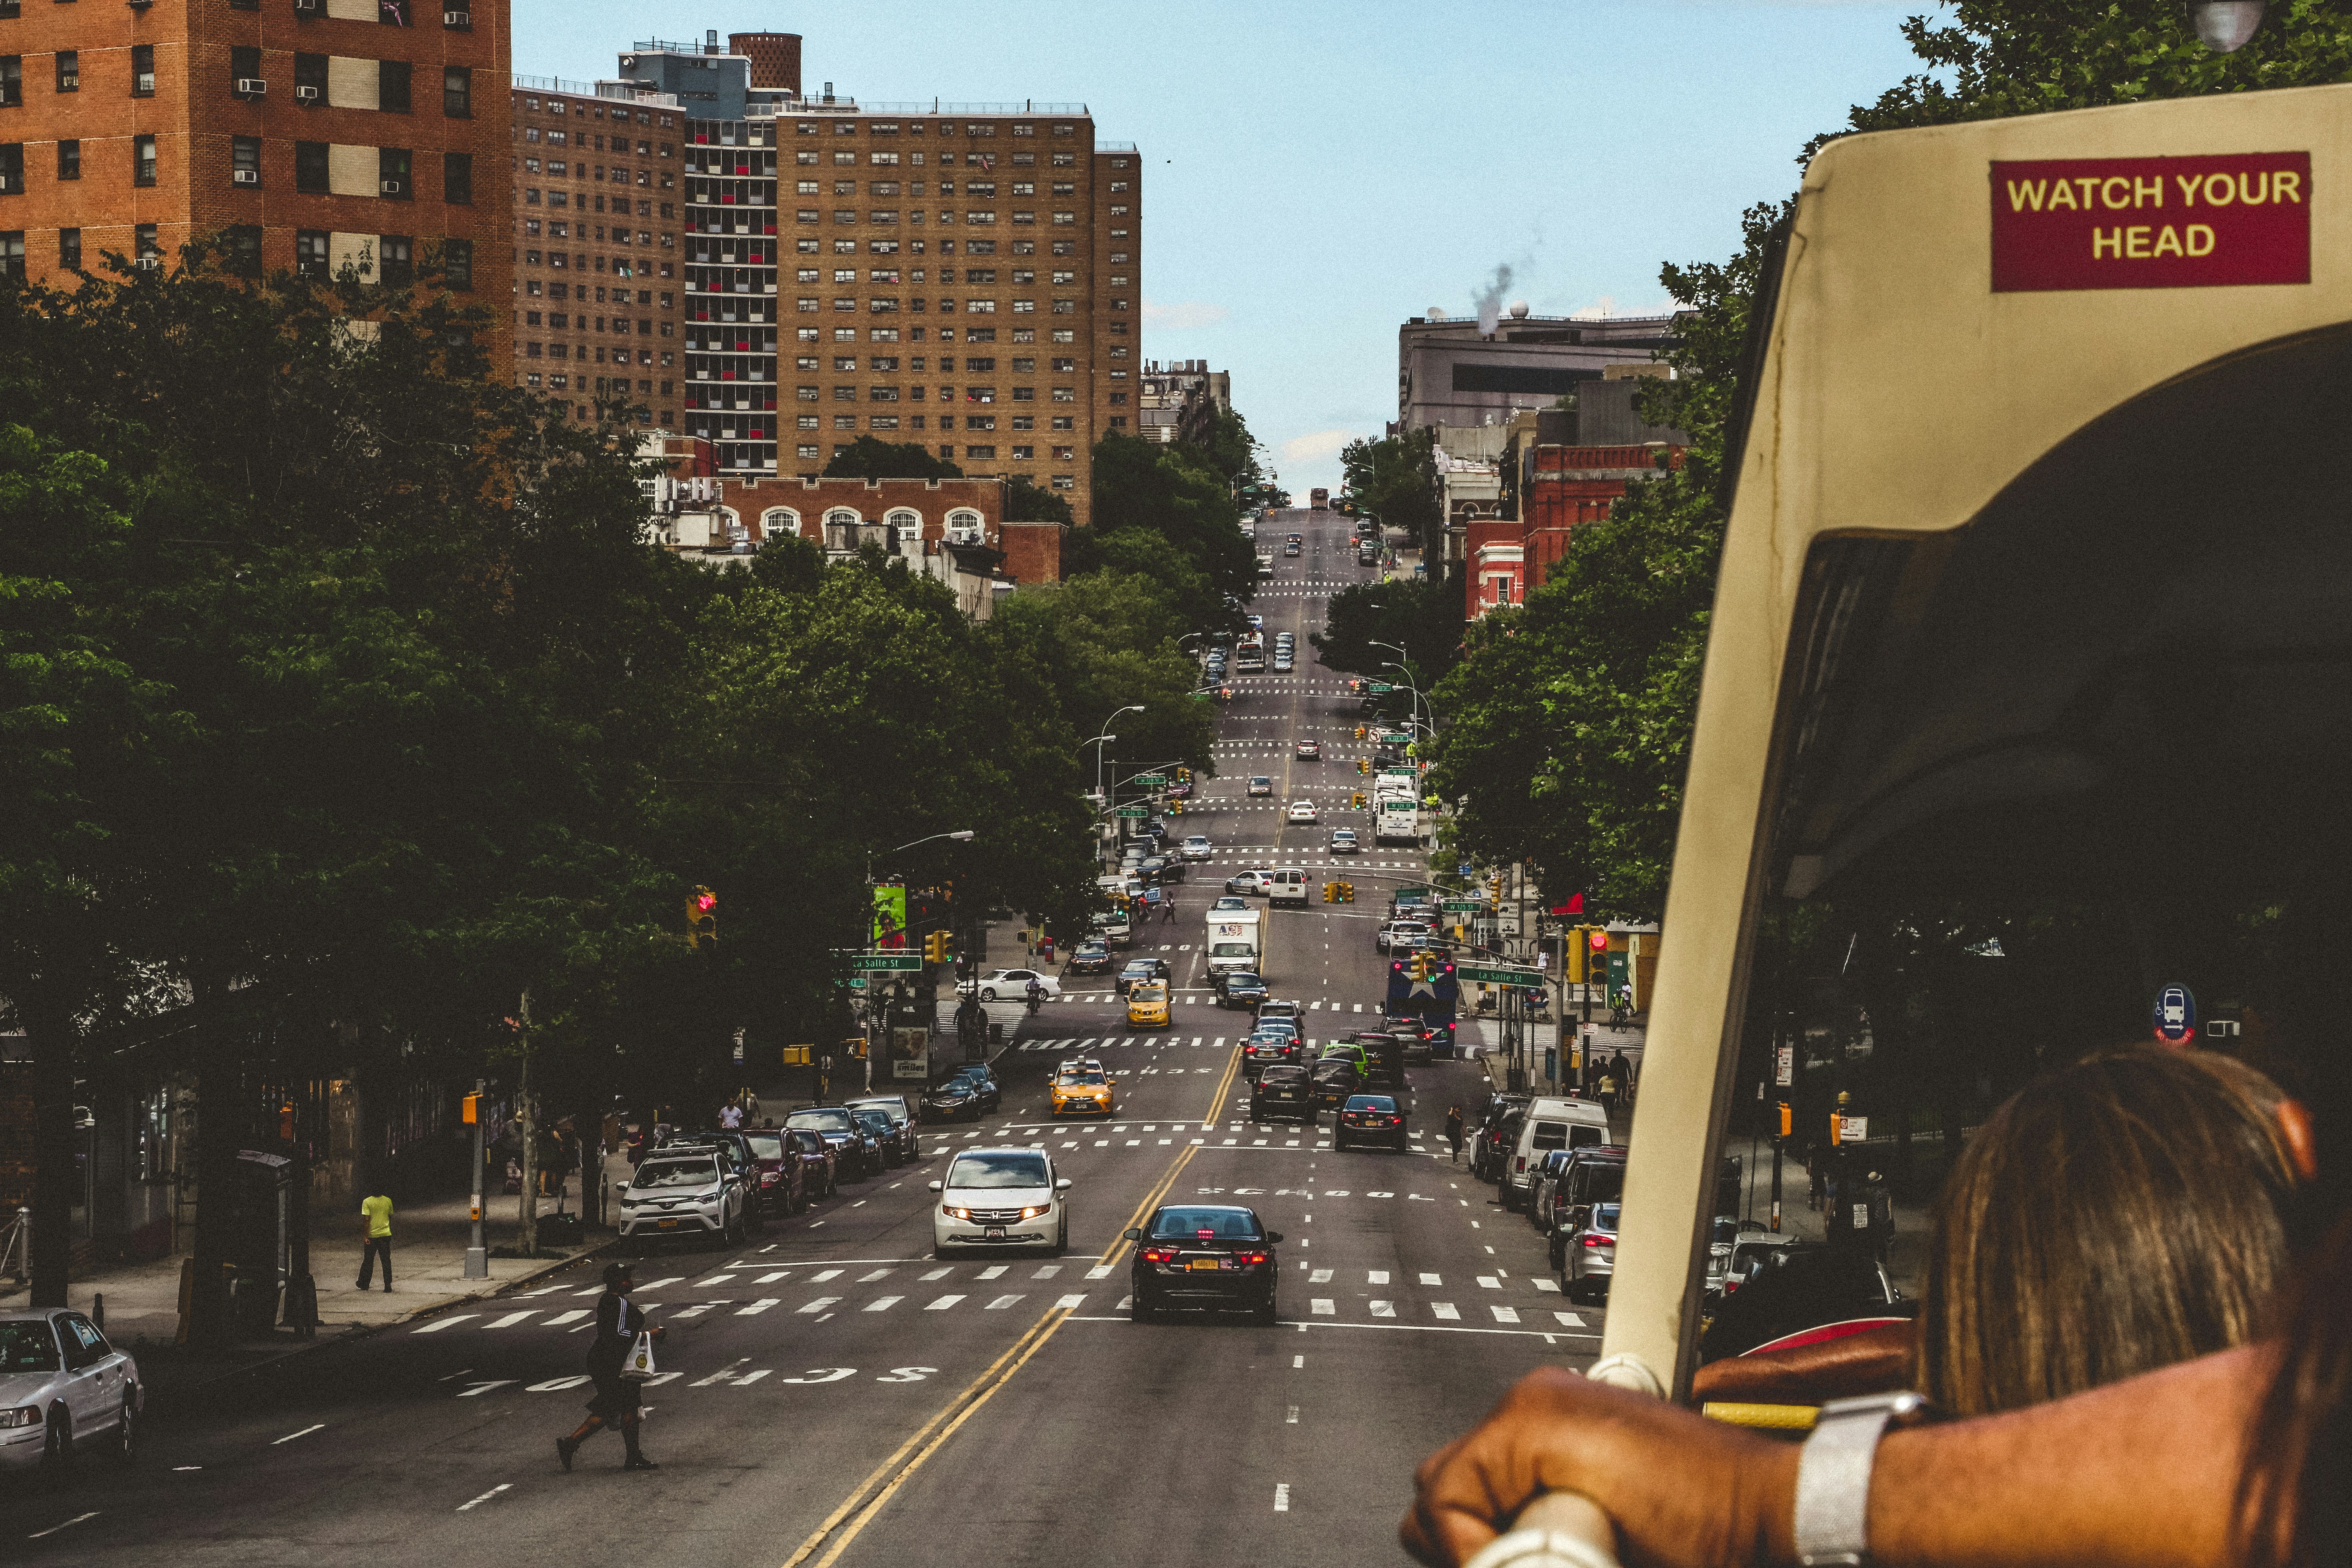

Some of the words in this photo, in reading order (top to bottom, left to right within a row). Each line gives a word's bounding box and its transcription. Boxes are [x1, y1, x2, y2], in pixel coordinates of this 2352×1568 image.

[2007, 175, 2163, 212] WATCH
[2176, 171, 2301, 206] YOUR
[2092, 224, 2216, 260] HEAD
[865, 959, 886, 967] Salle
[1491, 973, 1511, 981] Salle
[2156, 1030, 2164, 1040] NO
[897, 1063, 925, 1071] smiles
[1198, 1188, 1435, 1201] SCHOOL
